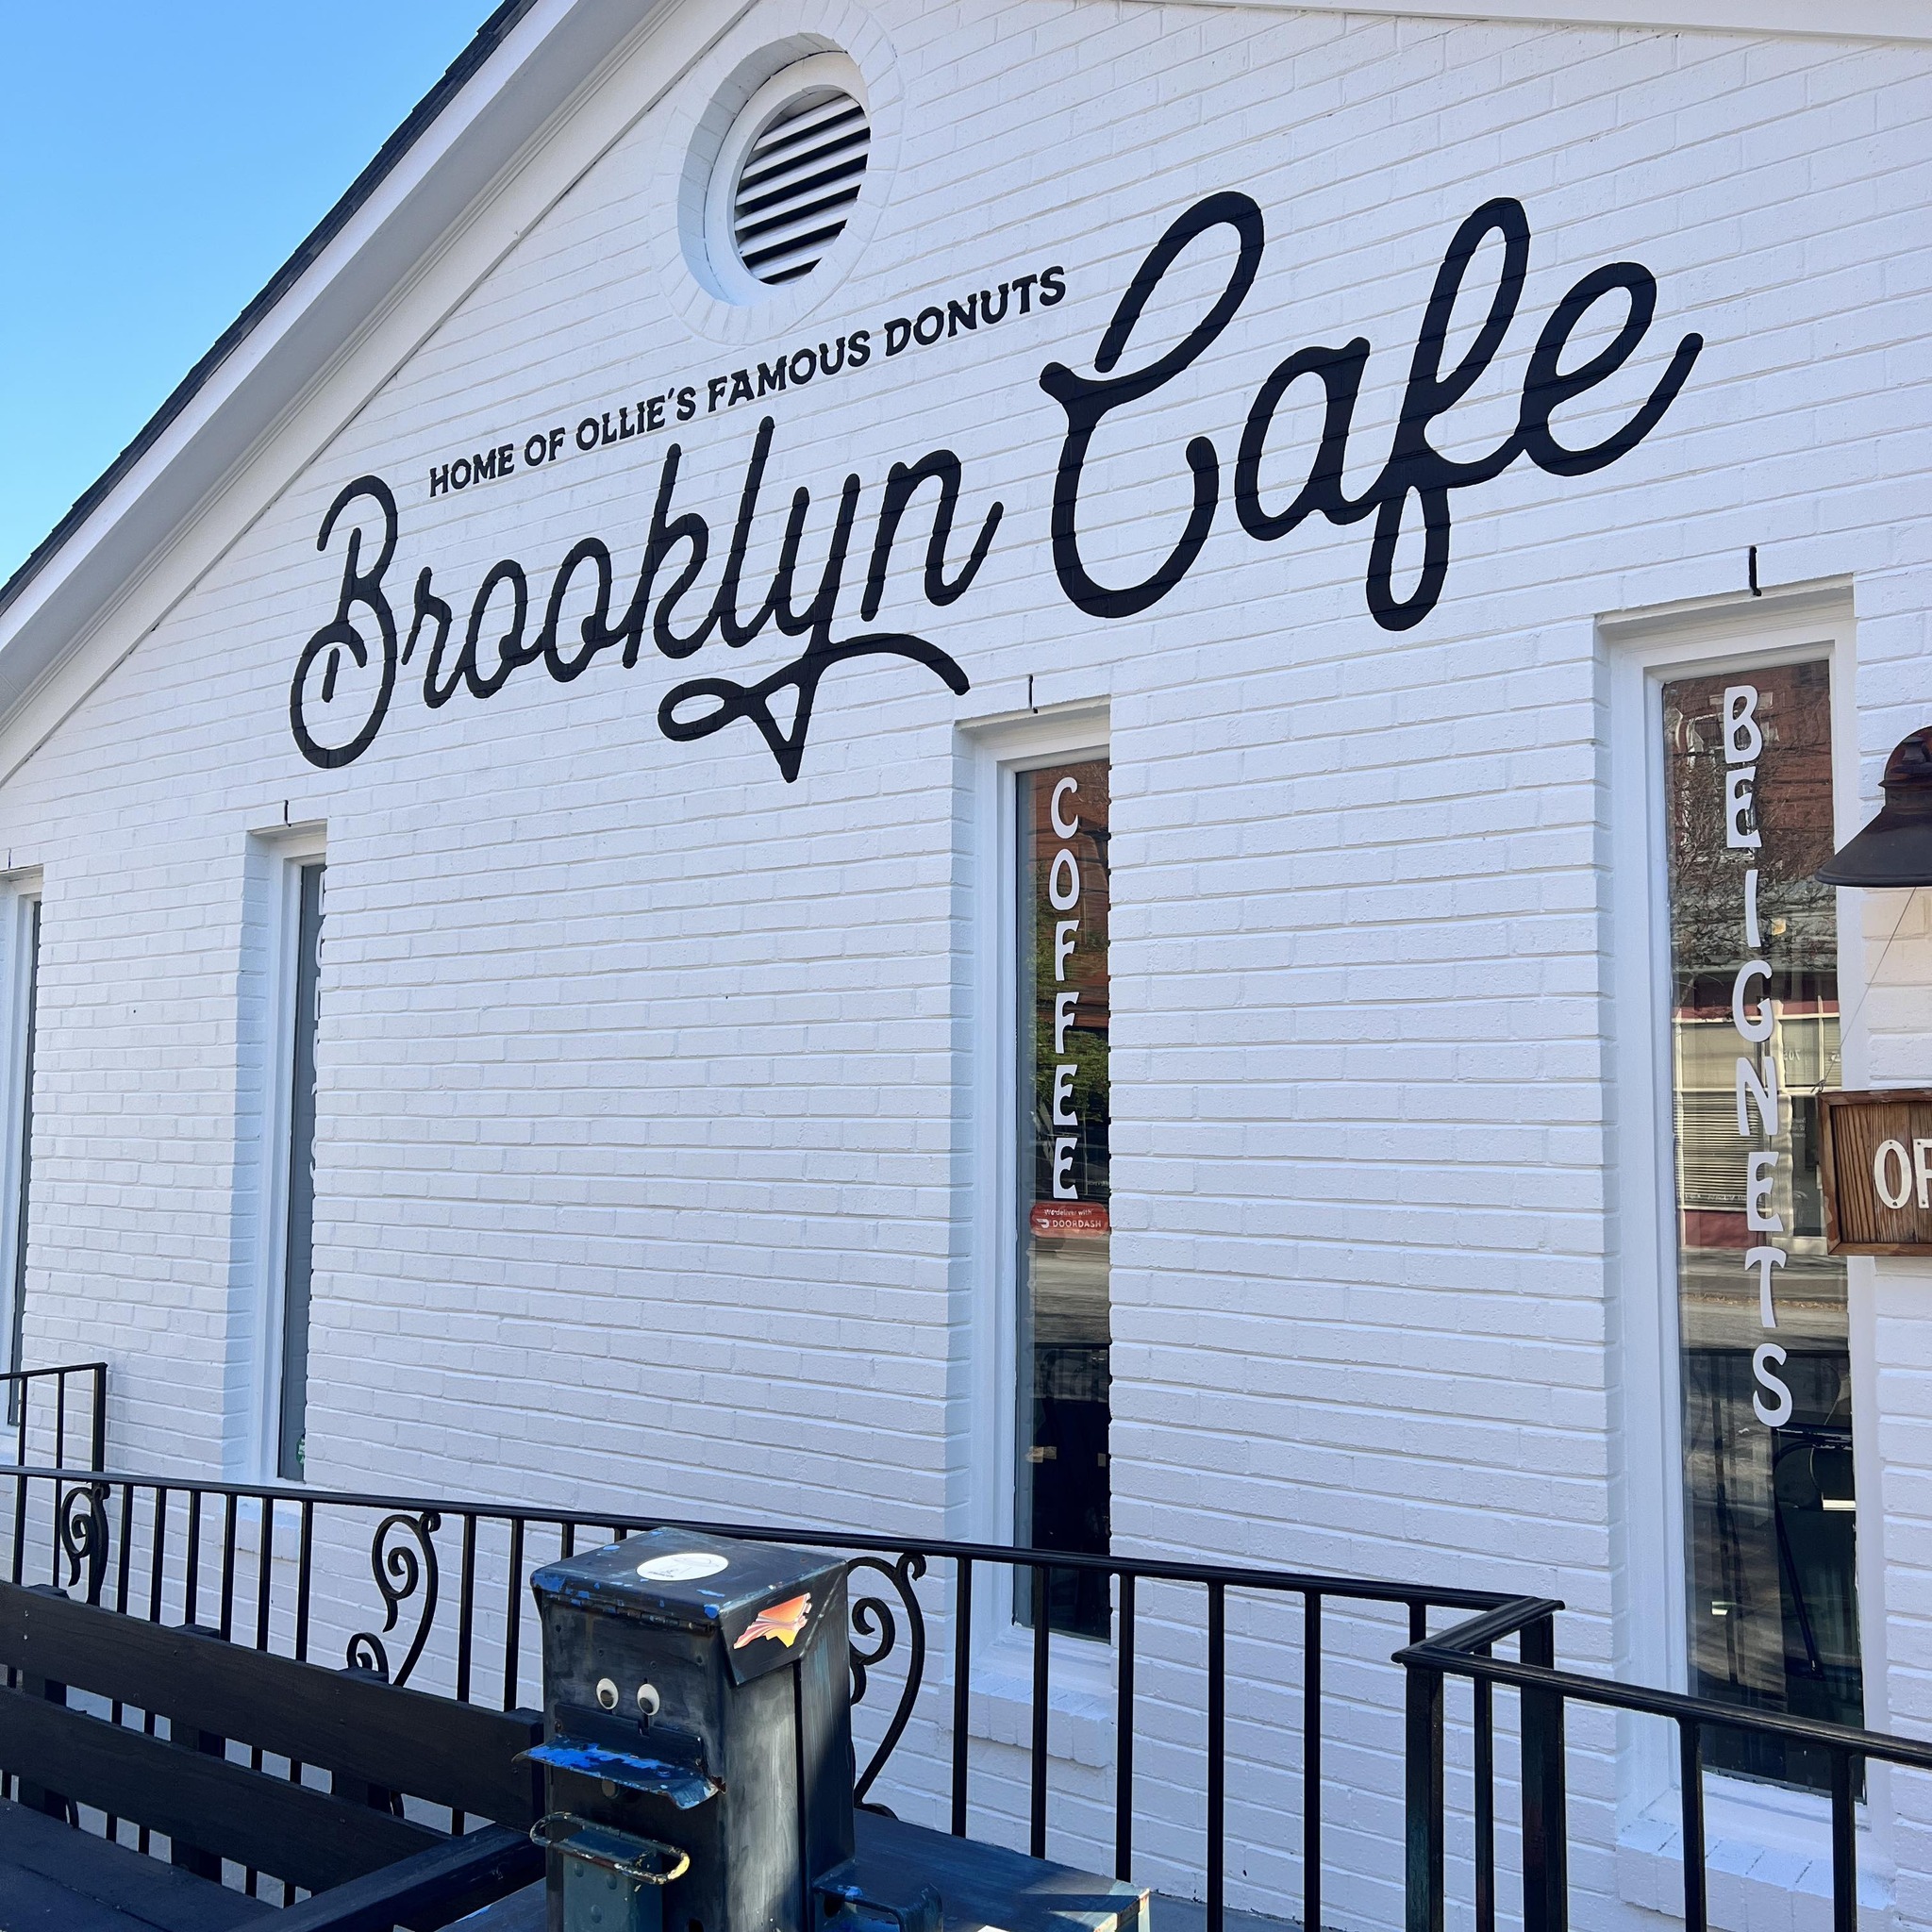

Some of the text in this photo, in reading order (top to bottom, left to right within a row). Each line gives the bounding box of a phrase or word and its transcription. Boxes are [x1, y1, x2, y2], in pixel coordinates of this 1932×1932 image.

[290, 192, 1703, 783] Brooklyn Cafe
[430, 266, 1066, 497] HOME OF OLLIE'S FAMOUS DONUTS
[1049, 776, 1080, 1200] COFFEE
[1722, 685, 1792, 1427] BEIGNETS
[1052, 1220, 1102, 1228] DOORDASH
